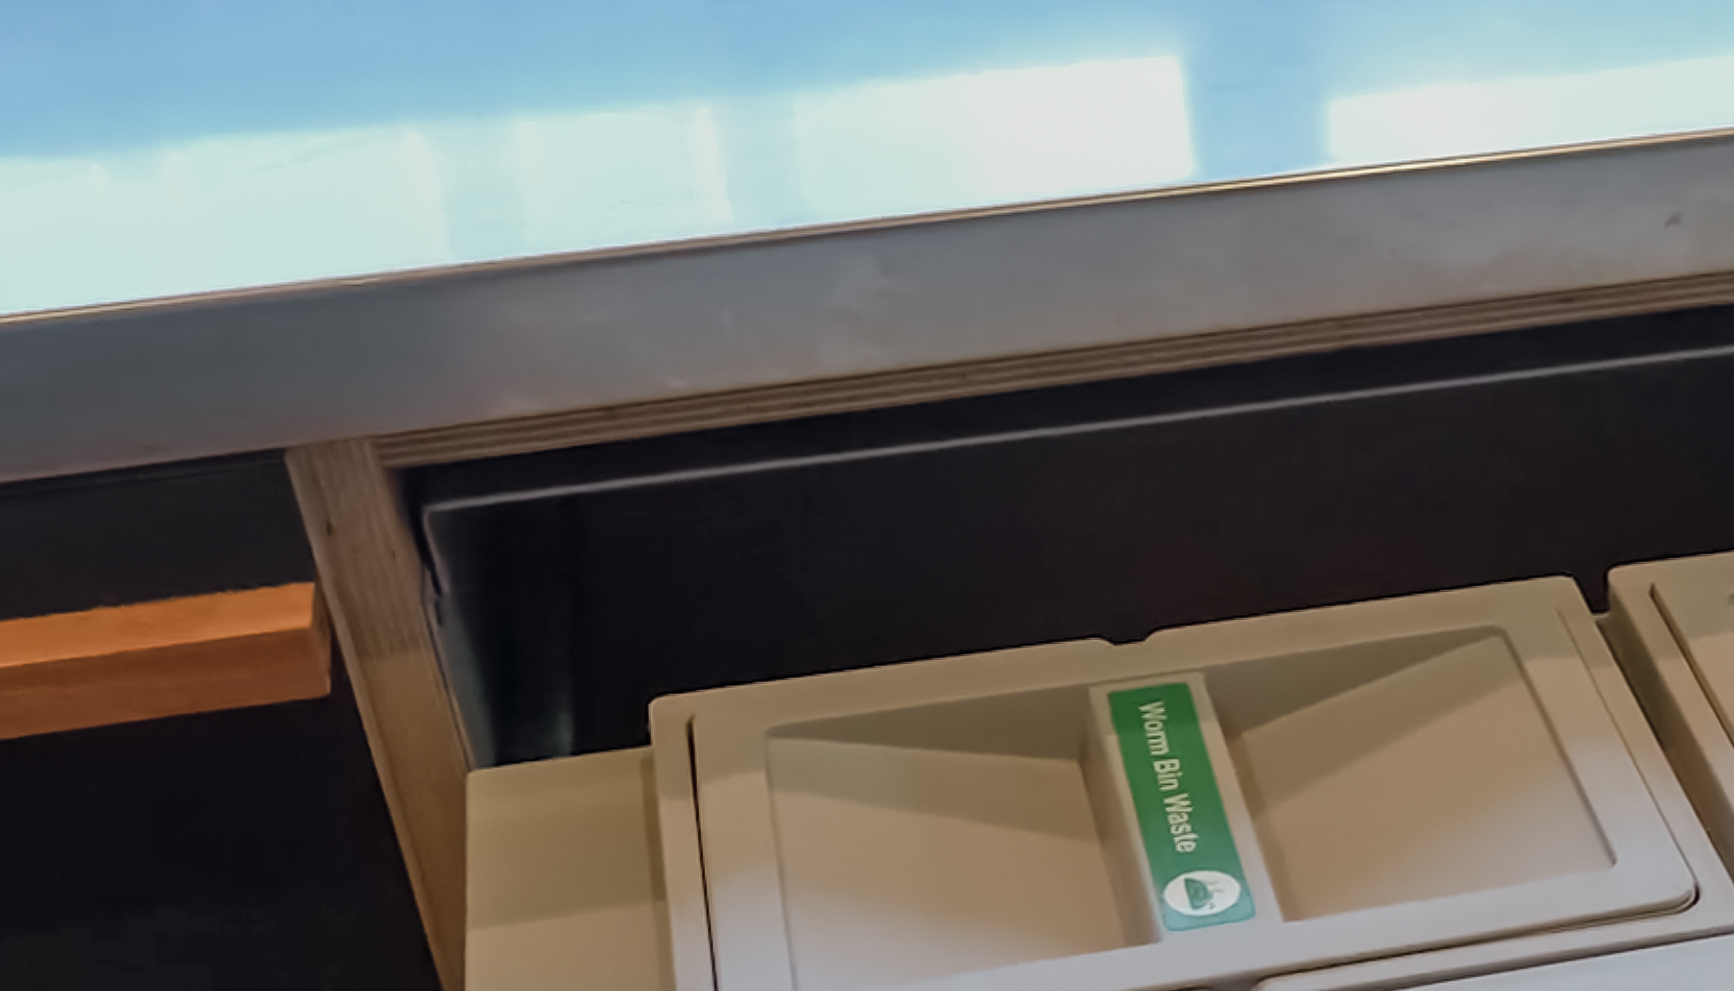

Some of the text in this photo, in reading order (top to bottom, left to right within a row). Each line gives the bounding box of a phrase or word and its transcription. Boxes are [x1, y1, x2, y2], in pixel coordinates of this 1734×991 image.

[1138, 701, 1200, 853] Worm Bin Waste
